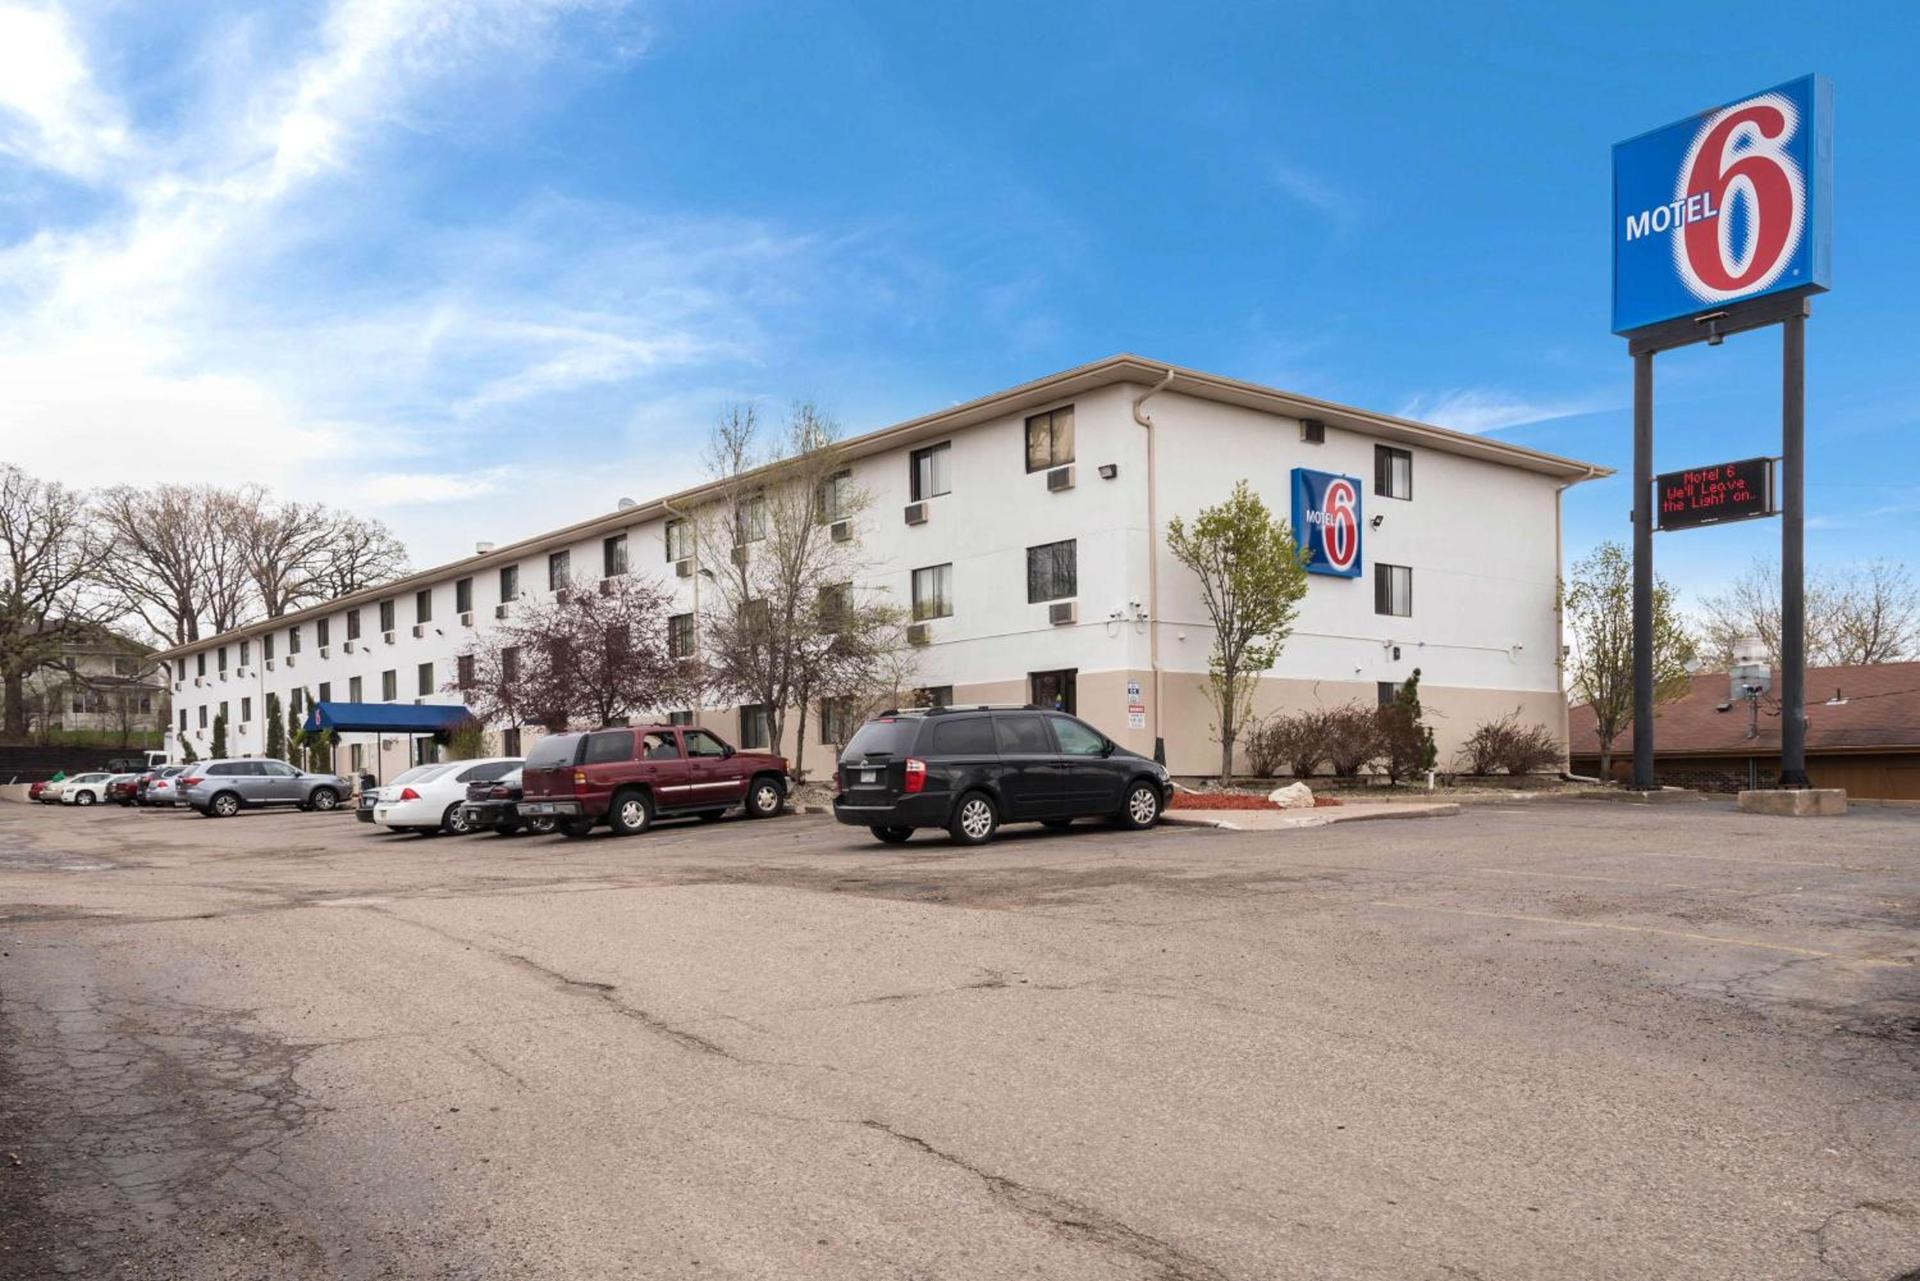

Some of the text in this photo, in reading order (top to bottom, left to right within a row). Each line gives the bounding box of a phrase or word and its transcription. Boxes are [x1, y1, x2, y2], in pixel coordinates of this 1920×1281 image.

[1626, 99, 1799, 297] MOTEL 6
[1684, 465, 1736, 484] Motel 6
[1667, 479, 1745, 499] We'll Leave
[1663, 500, 1684, 512] the
[1692, 493, 1724, 508] Light
[1306, 481, 1357, 569] MOTEL 6
